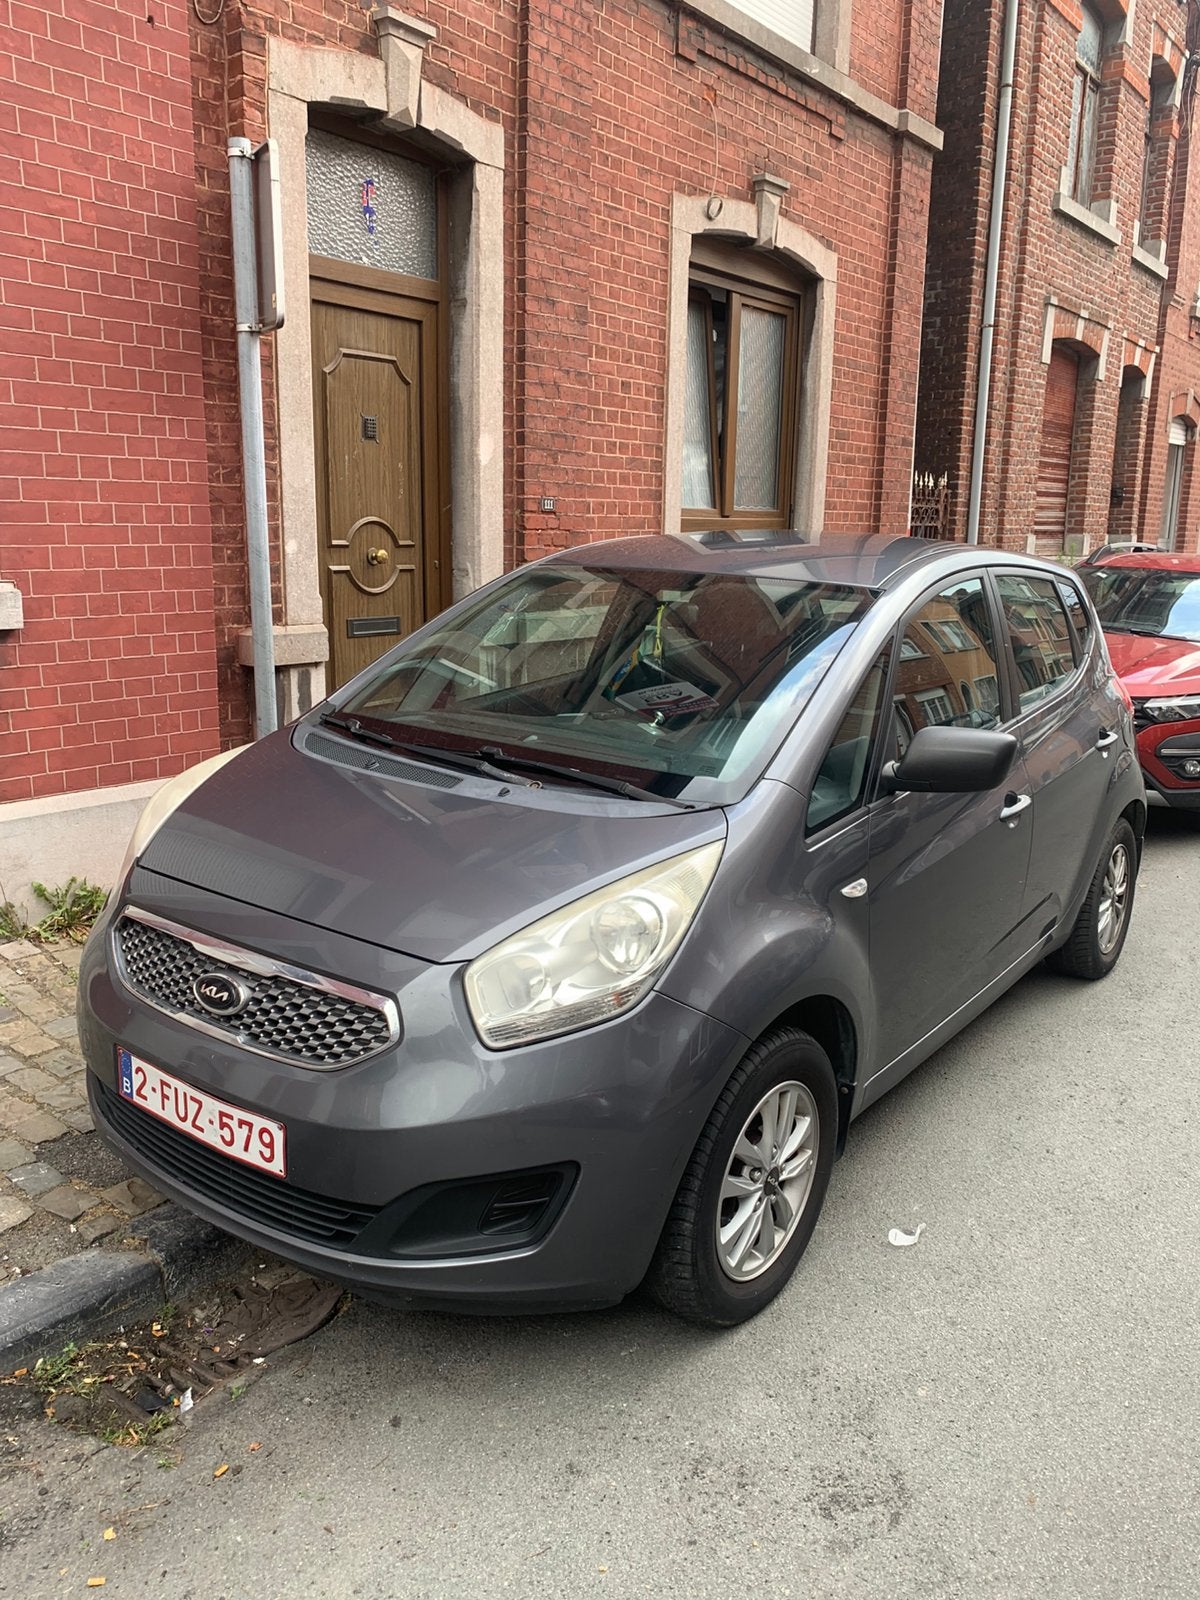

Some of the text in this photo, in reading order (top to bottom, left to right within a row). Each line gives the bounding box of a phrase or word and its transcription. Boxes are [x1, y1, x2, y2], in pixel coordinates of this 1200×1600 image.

[200, 983, 229, 1001] KIA
[123, 1066, 275, 1163] B 2-FUZ-579
